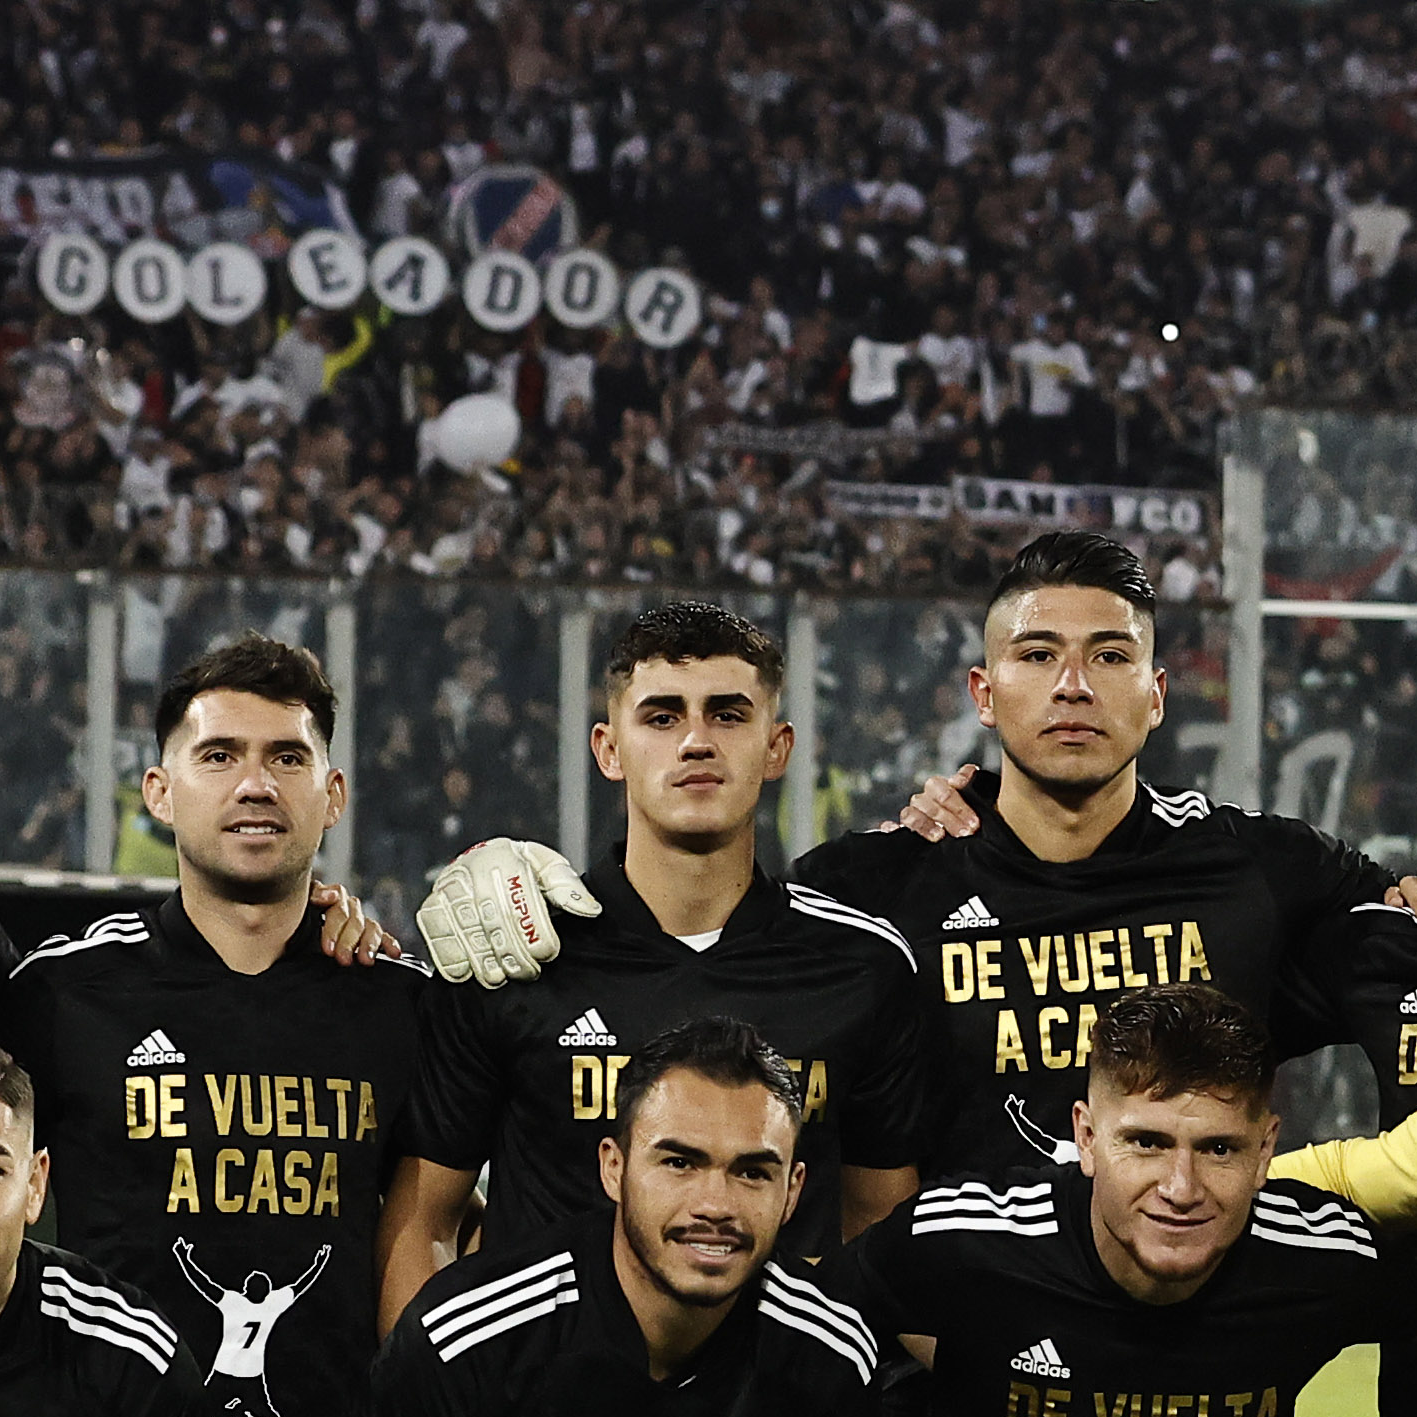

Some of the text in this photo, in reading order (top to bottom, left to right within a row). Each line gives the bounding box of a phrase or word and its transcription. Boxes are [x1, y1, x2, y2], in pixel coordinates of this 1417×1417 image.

[942, 915, 1000, 930] adidas
[941, 920, 1213, 1005] DE VUELTA
[558, 1031, 618, 1047] adidas
[994, 1008, 1030, 1075] A
[126, 1050, 186, 1067] adidas
[124, 1073, 379, 1143] DE VUELTA
[165, 1147, 341, 1218] A CASA
[243, 1320, 262, 1350] 7
[1010, 1356, 1072, 1379] adidas
